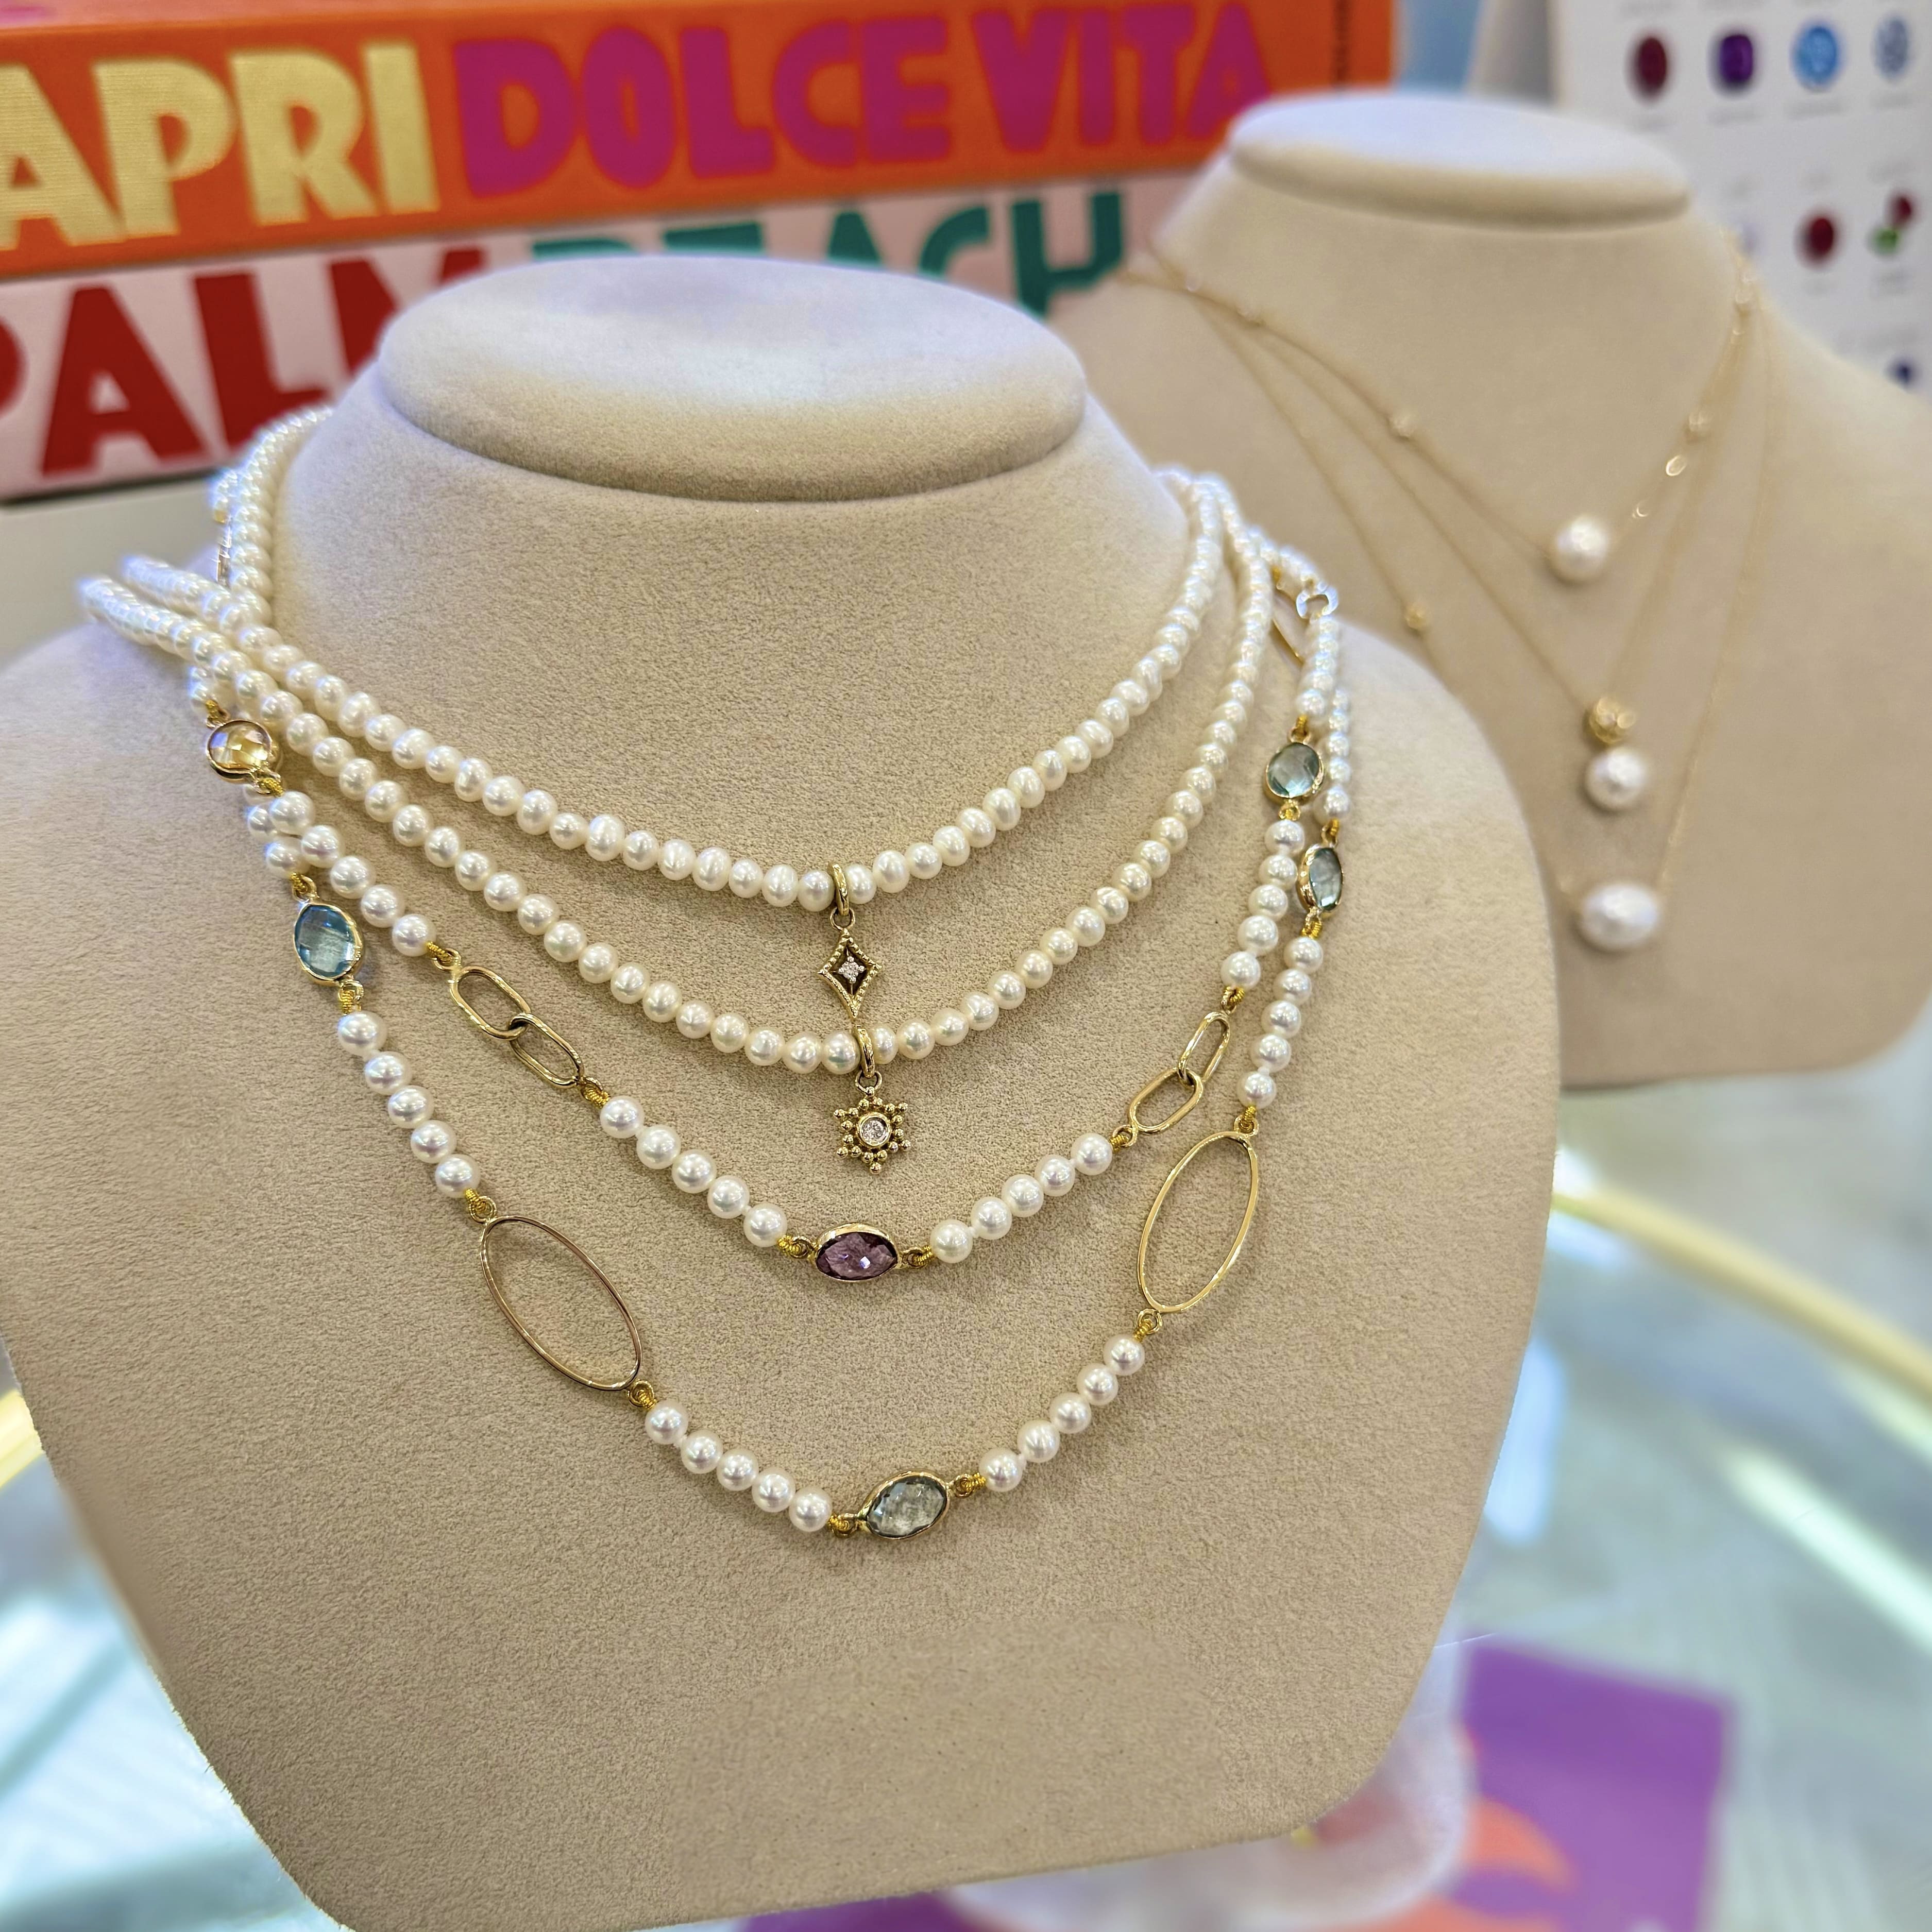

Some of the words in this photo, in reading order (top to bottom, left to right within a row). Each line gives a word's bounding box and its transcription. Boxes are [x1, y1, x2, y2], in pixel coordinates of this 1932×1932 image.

[452, 16, 951, 199] DOLCE
[972, 2, 1272, 153] VITA
[0, 245, 487, 477] AL
